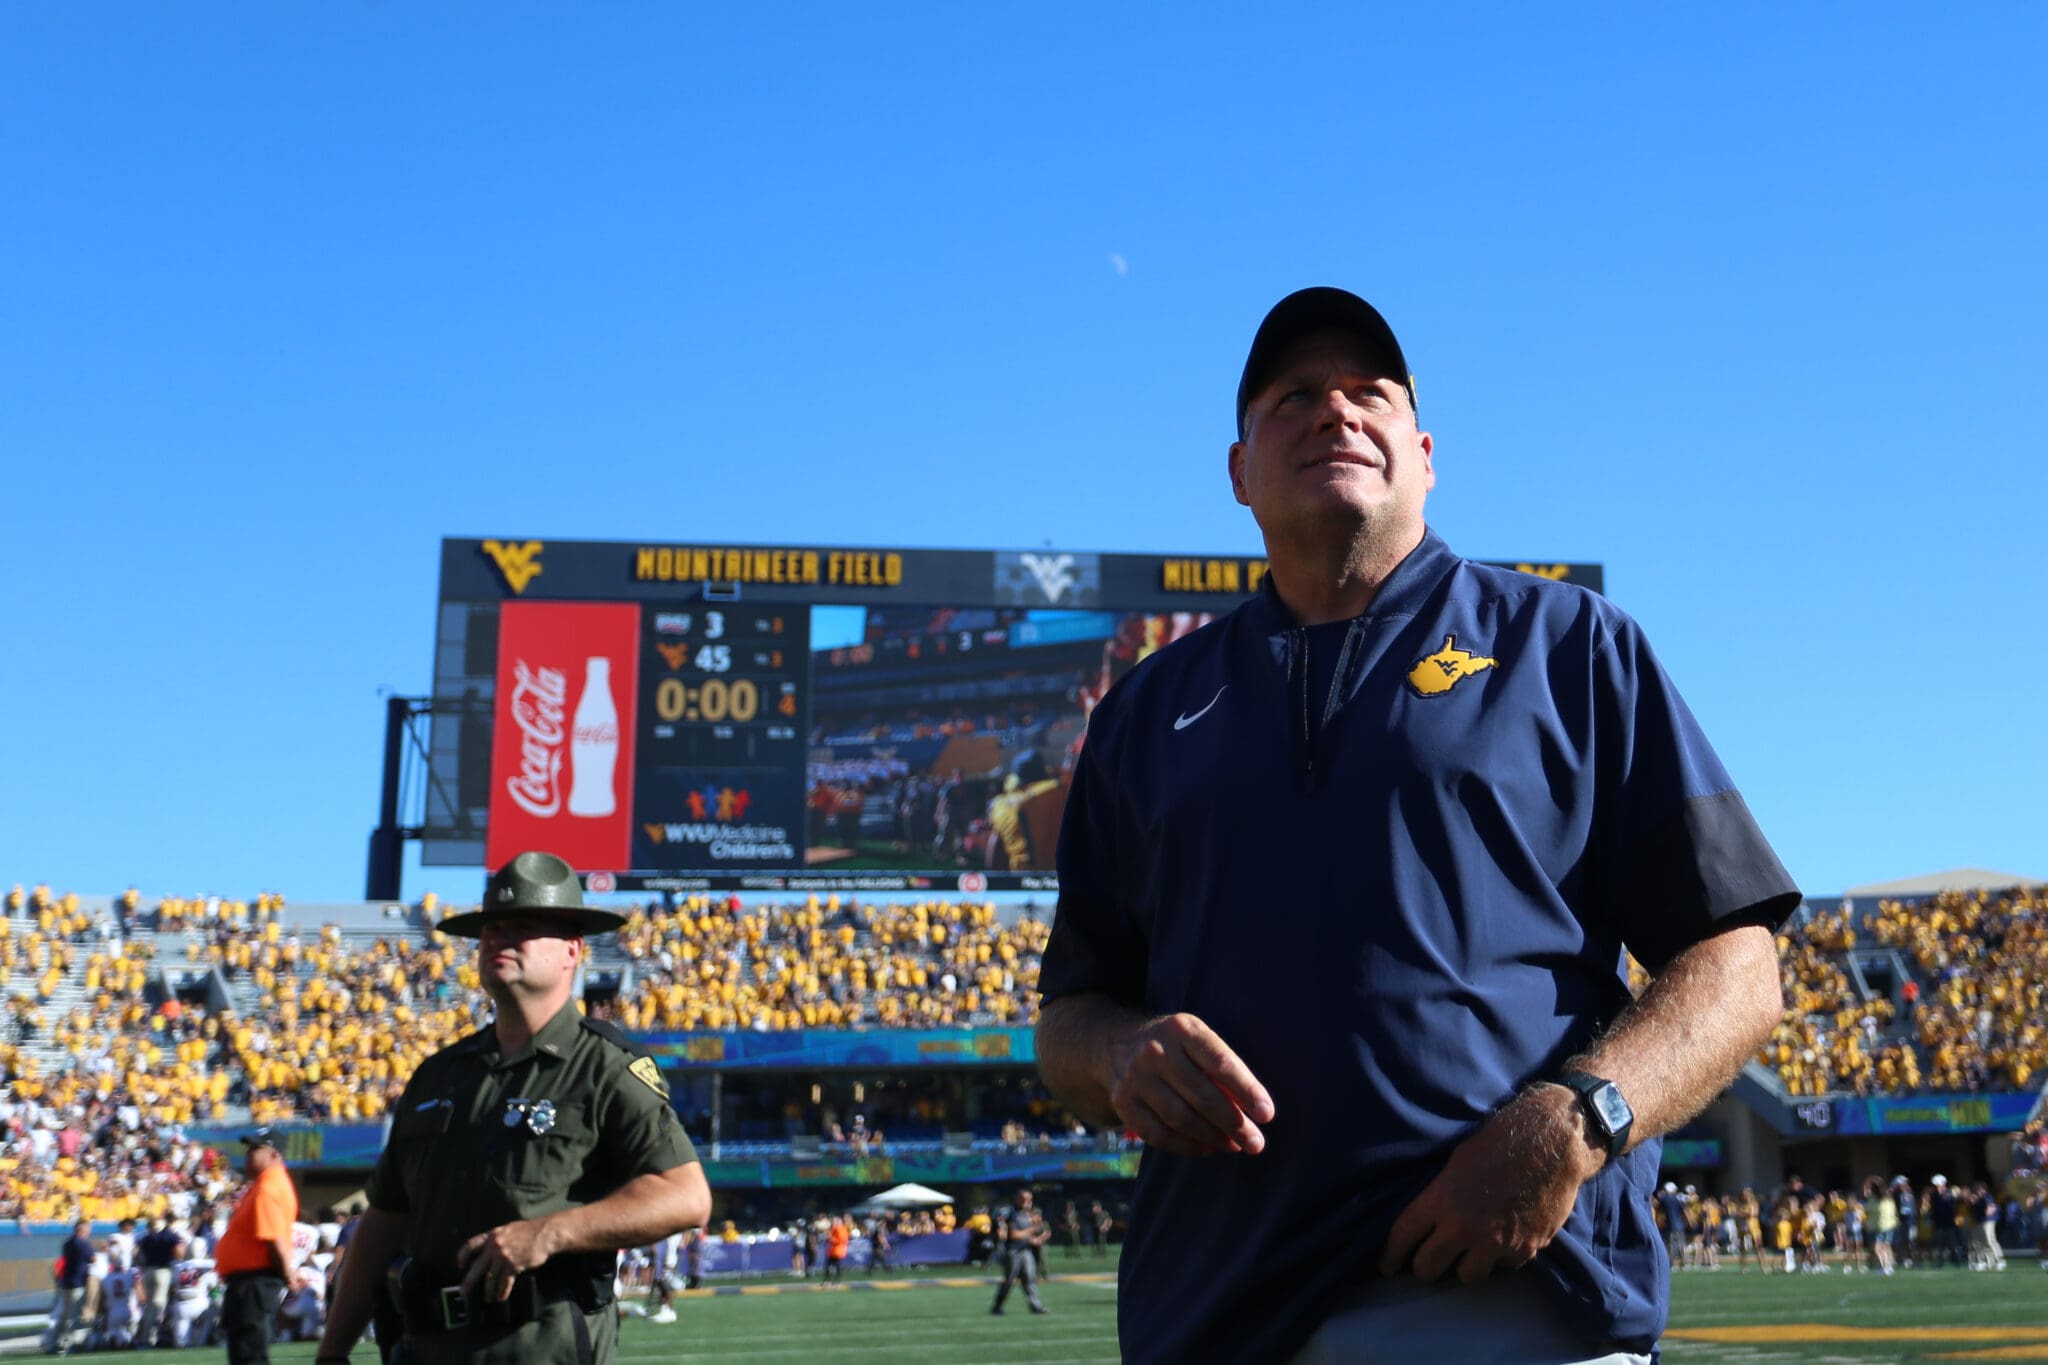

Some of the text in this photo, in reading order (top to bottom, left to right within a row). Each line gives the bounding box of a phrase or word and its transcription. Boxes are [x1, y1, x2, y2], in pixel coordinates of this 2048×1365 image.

[636, 547, 902, 584] MOUNTAINEER FIELD
[1163, 560, 1239, 592] MILAN
[705, 611, 725, 639] 3
[695, 644, 732, 672] 45
[656, 677, 758, 722] 0:00
